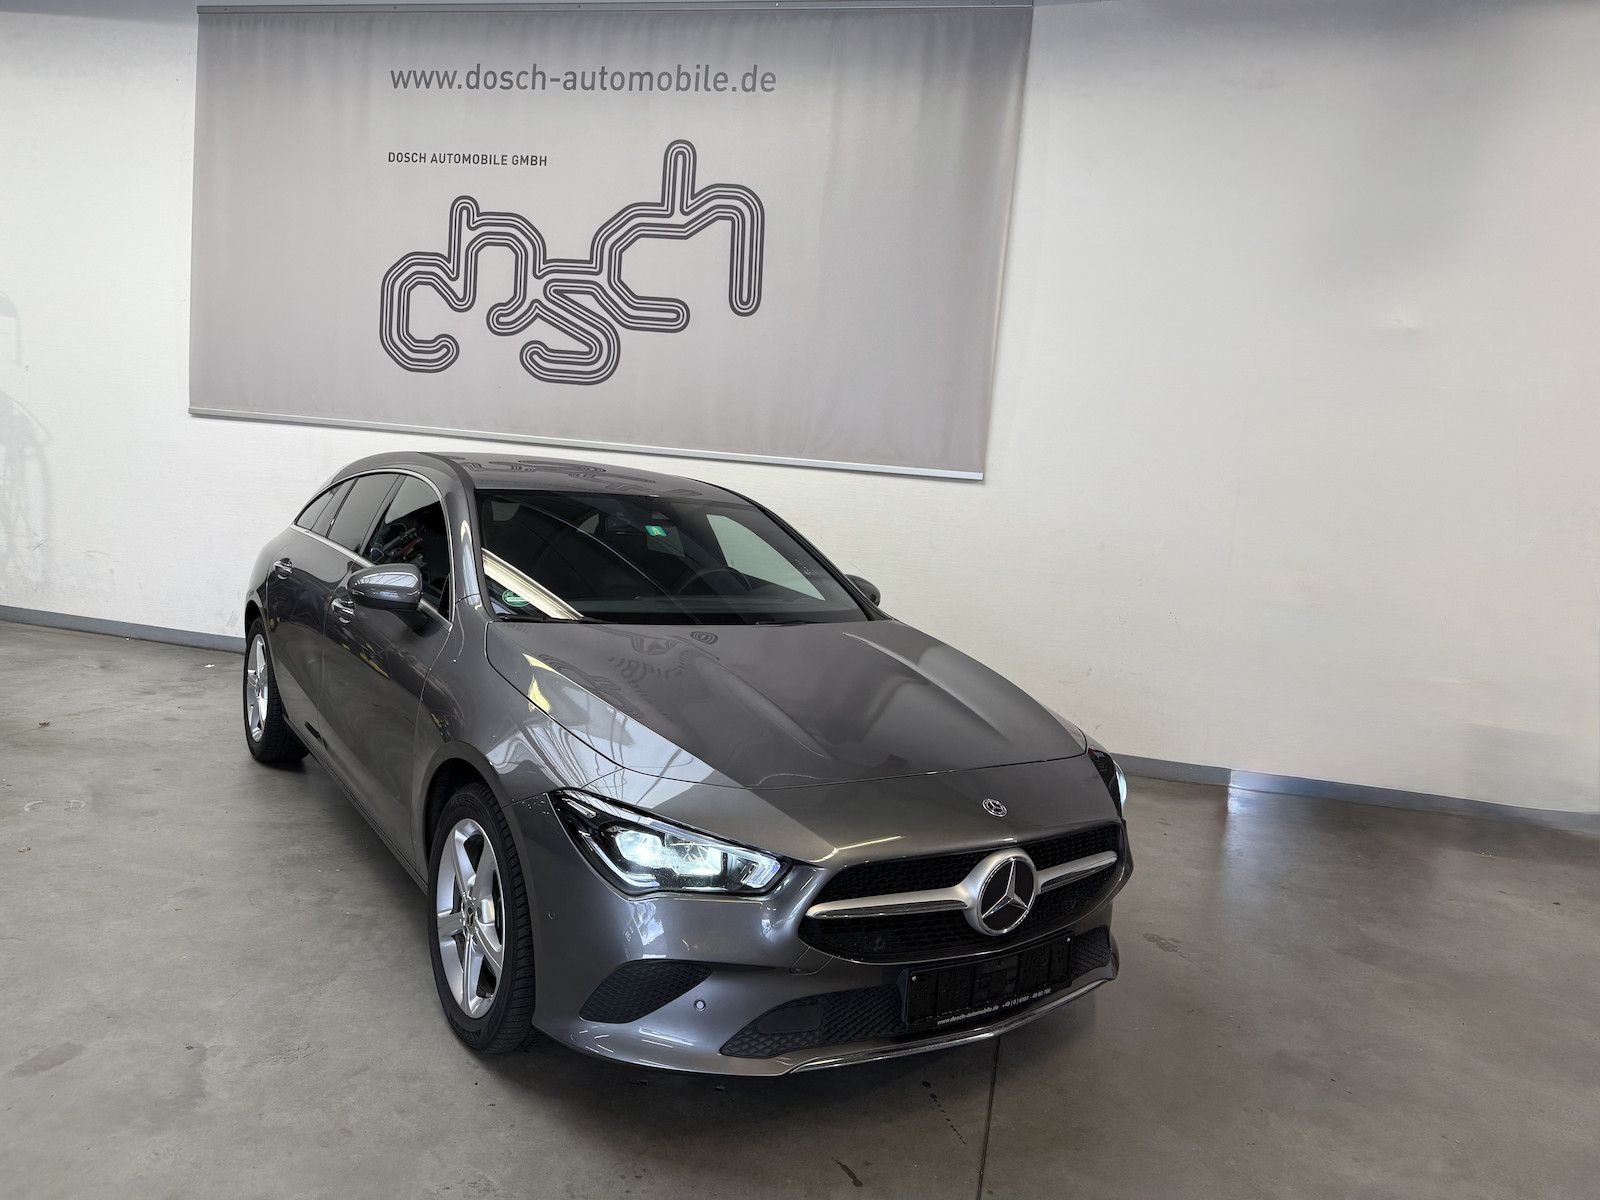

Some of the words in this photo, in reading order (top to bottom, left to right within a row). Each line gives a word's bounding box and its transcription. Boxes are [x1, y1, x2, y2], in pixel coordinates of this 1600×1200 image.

[390, 63, 777, 93] www.dosch-automobile.de
[388, 151, 427, 164] DOSCH
[430, 152, 508, 166] AUTOMOBILE
[511, 154, 548, 167] GMBH
